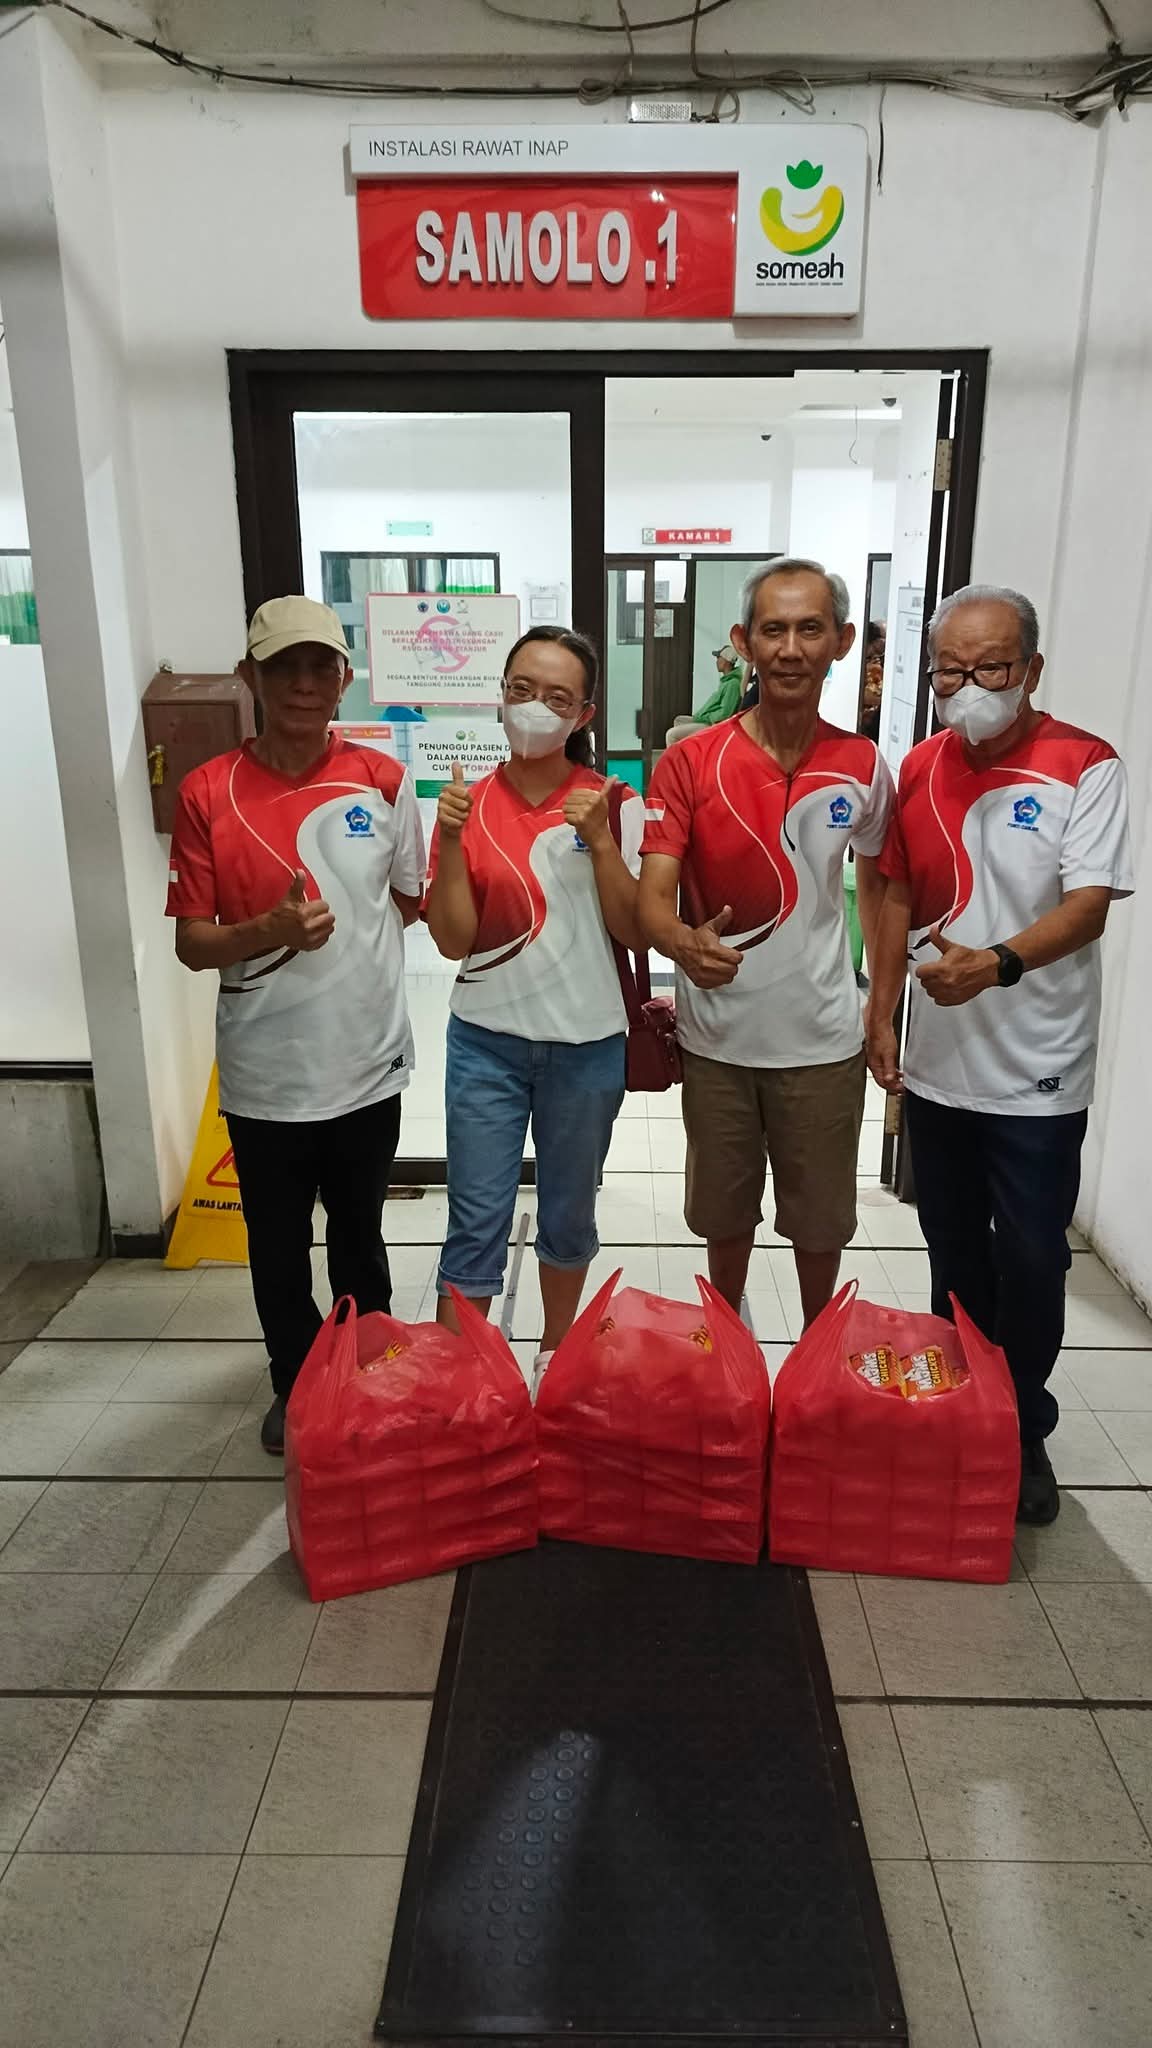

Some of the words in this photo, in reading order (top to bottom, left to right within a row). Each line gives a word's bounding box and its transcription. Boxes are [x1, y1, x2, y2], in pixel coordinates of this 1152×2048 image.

[368, 140, 457, 157] INSTALASI
[462, 140, 523, 157] RAWAT
[528, 140, 569, 156] INAP
[415, 209, 632, 285] SAMOLO
[756, 252, 844, 279] someah
[669, 532, 711, 540] KAMAR
[715, 532, 720, 540] 1
[419, 743, 468, 751] PENUNGGU
[471, 744, 502, 752] PASIEN
[471, 764, 498, 772] ORAN
[193, 1199, 215, 1209] AWAS
[216, 1201, 241, 1211] LANTA
[878, 1350, 889, 1382] CHICKEN
[928, 1352, 941, 1383] CHICKEN
